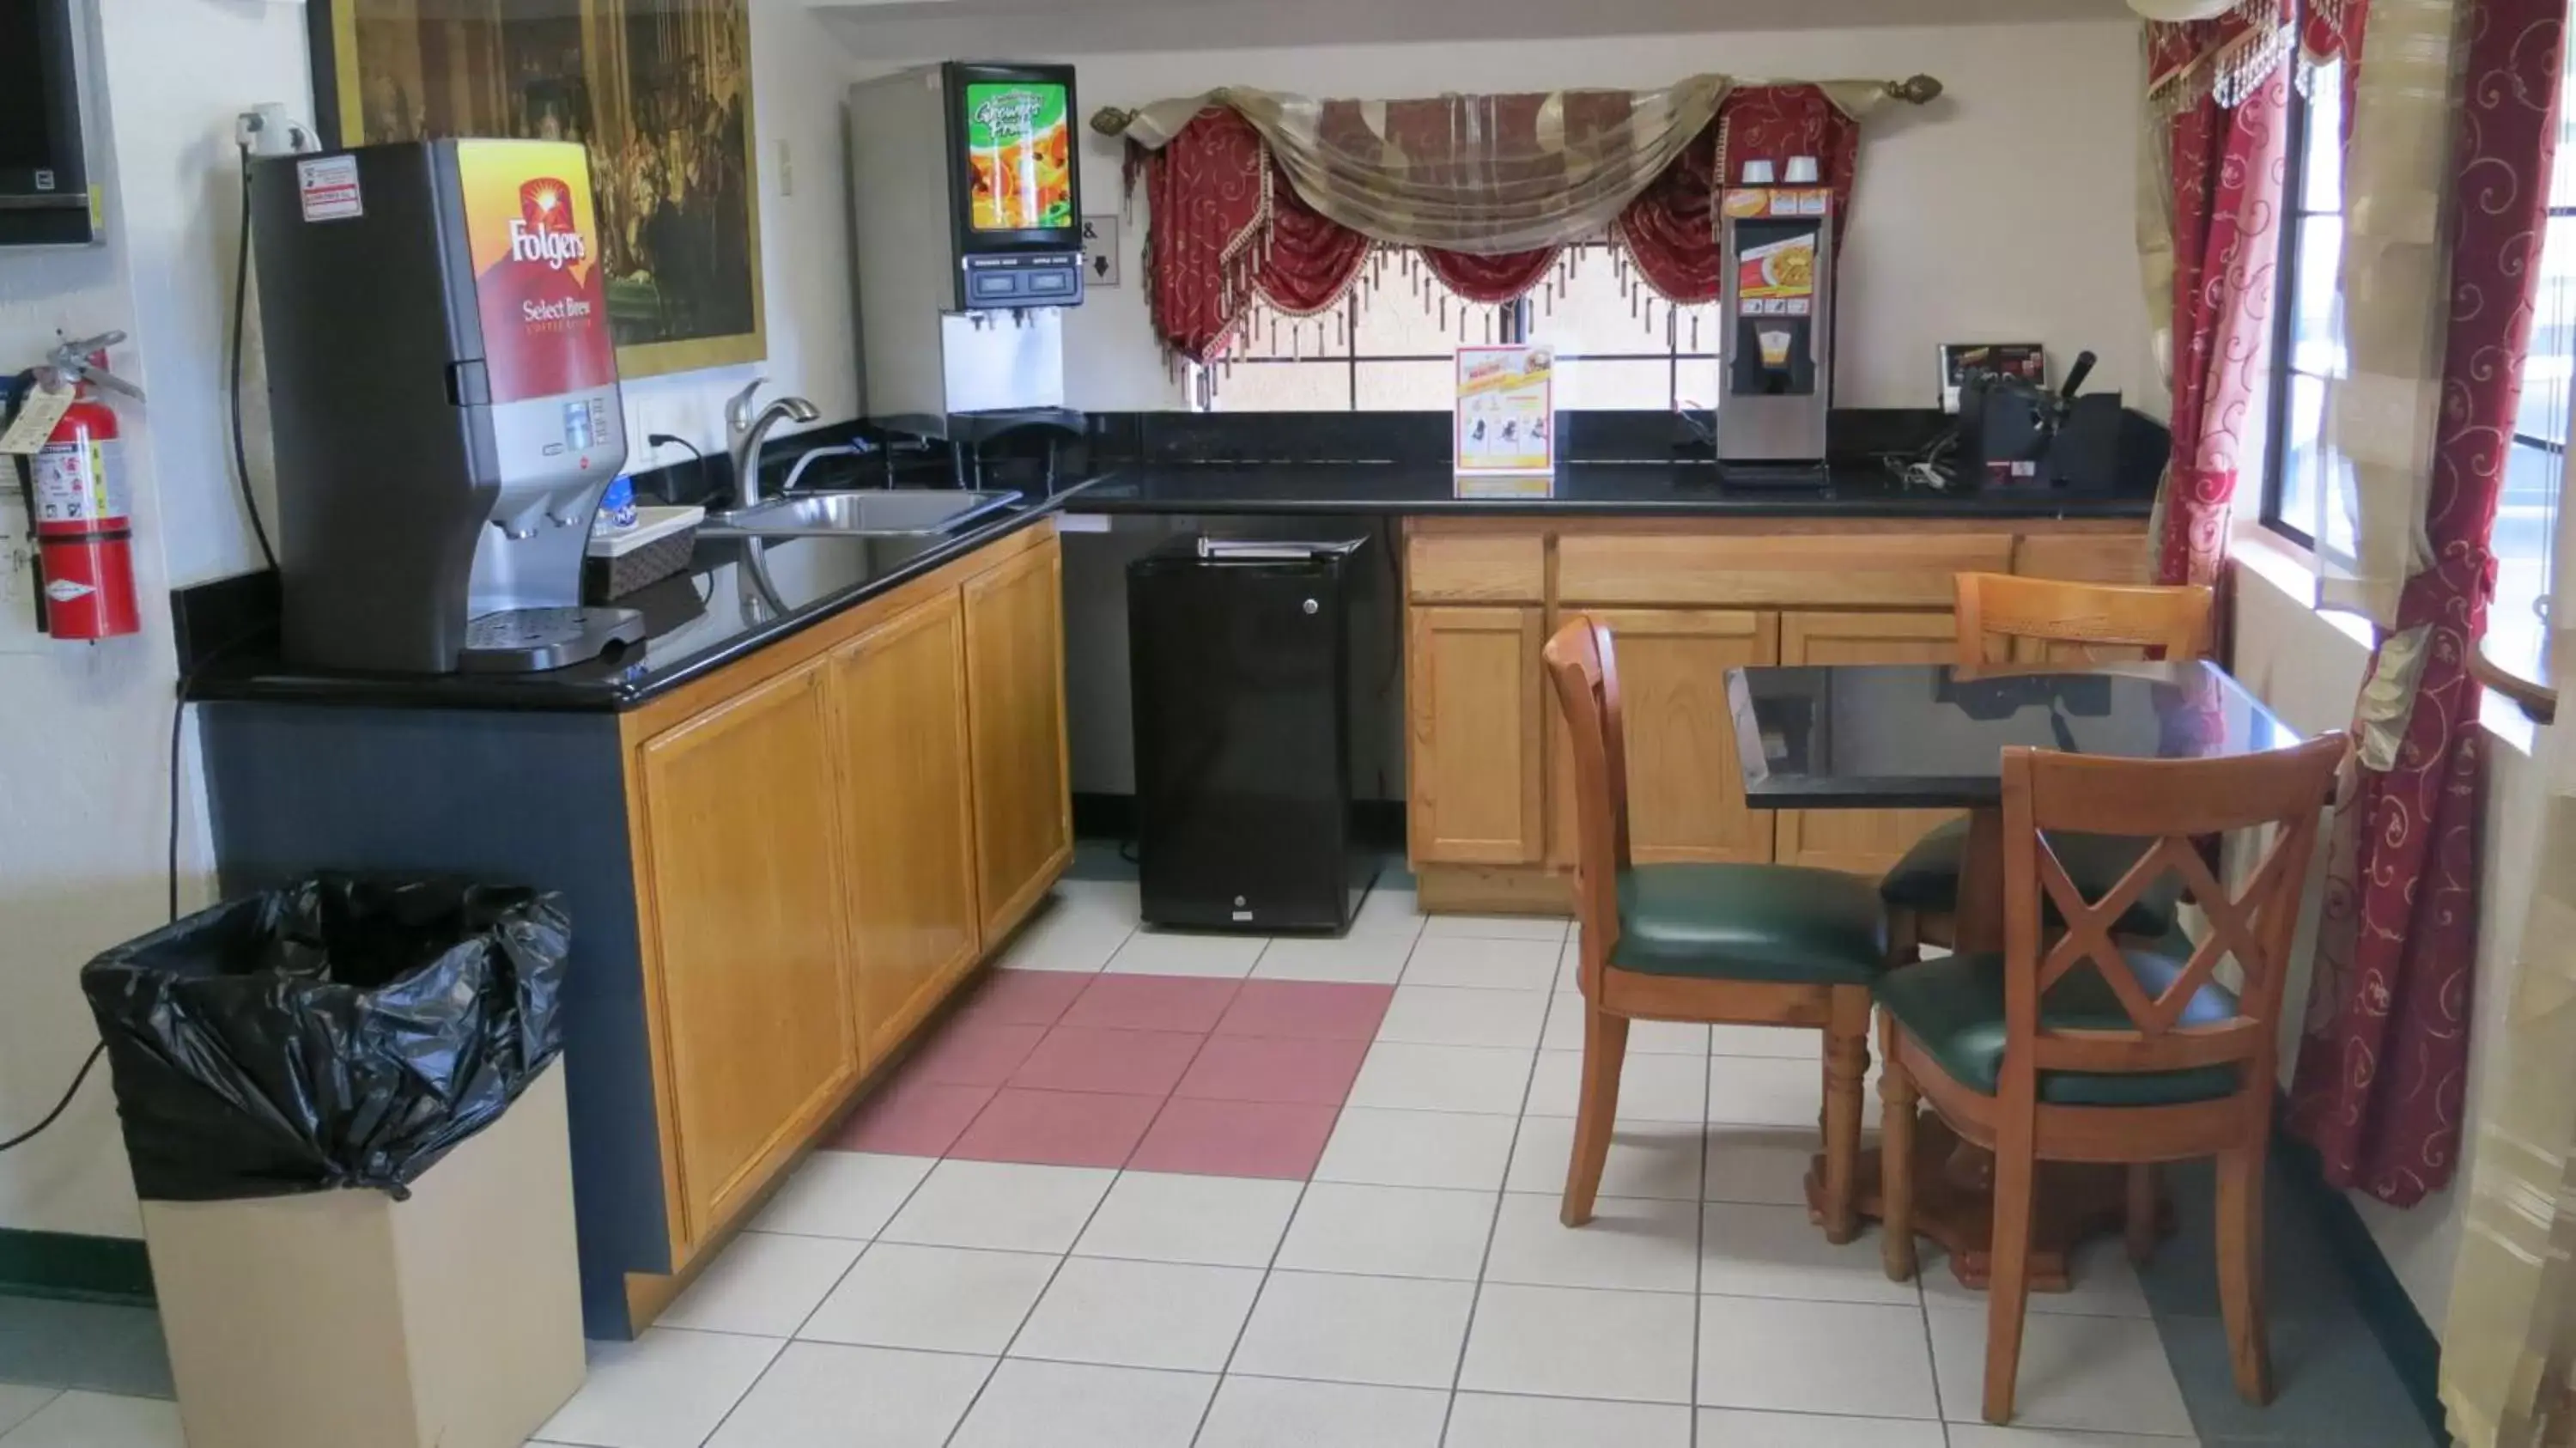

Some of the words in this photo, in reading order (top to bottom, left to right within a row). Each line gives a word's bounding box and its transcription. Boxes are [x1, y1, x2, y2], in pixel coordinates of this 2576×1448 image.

[509, 219, 585, 269] Folgers
[523, 299, 564, 321] Select
[565, 296, 590, 317] Brew
